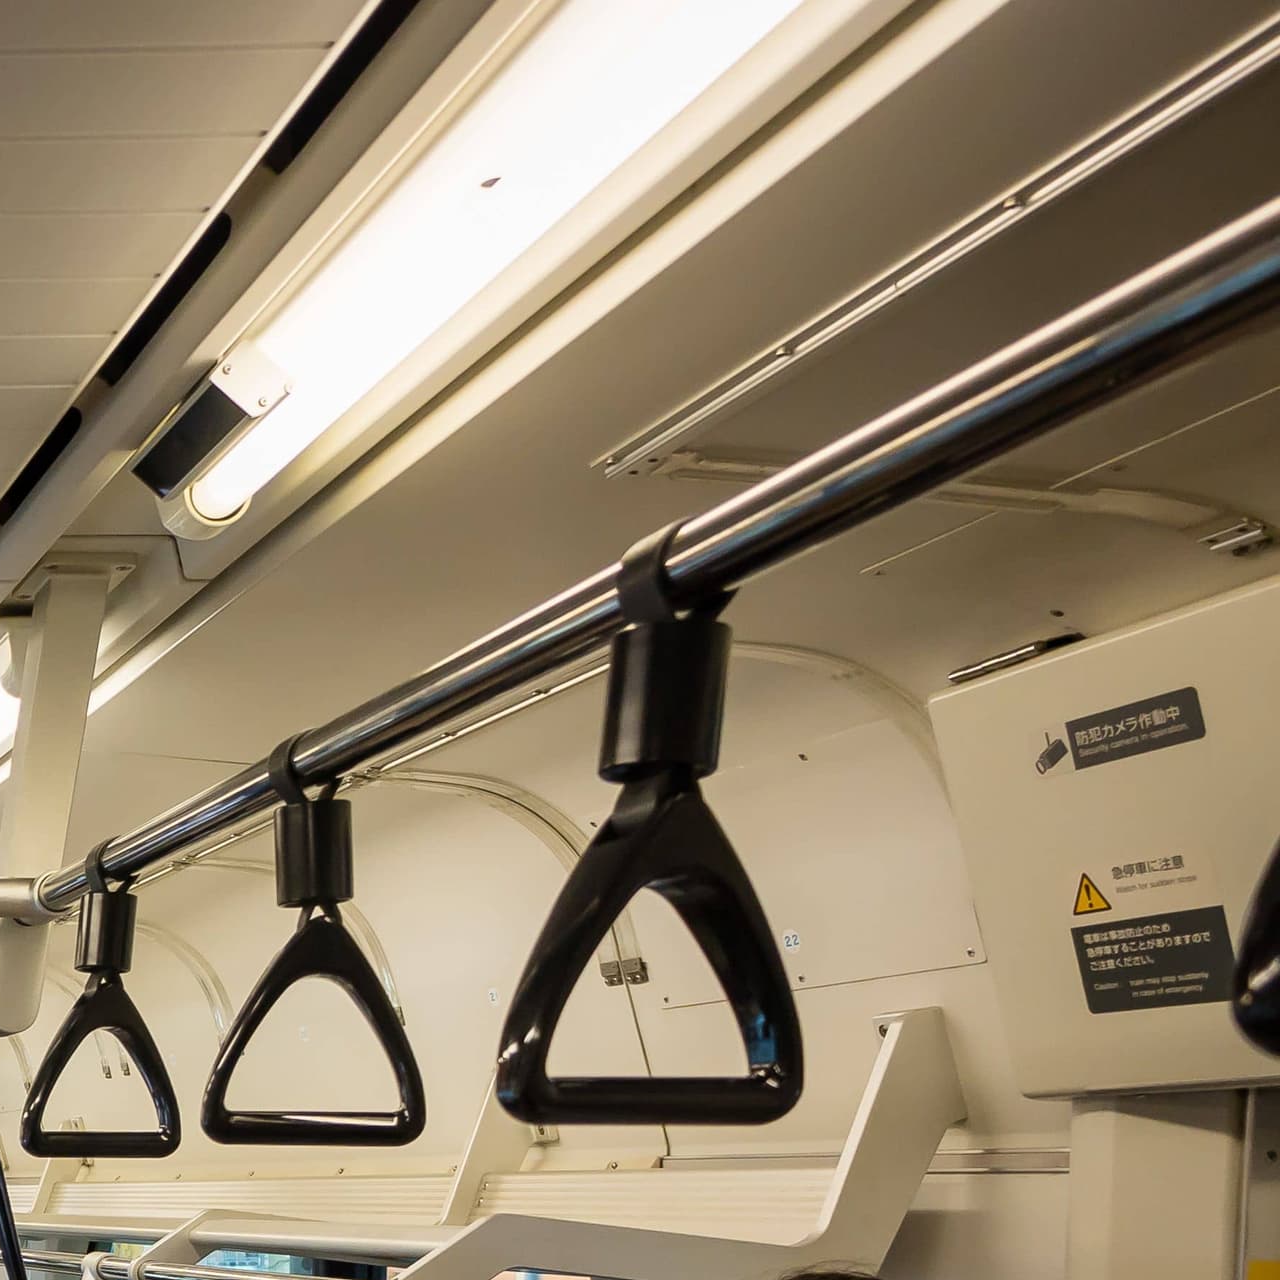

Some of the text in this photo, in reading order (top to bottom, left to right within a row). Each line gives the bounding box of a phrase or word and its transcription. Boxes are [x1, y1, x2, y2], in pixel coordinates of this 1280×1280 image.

[1074, 705, 1181, 747] 防犯カメラ作動中
[1111, 855, 1185, 880] 急停車に注意
[784, 934, 800, 948] 22
